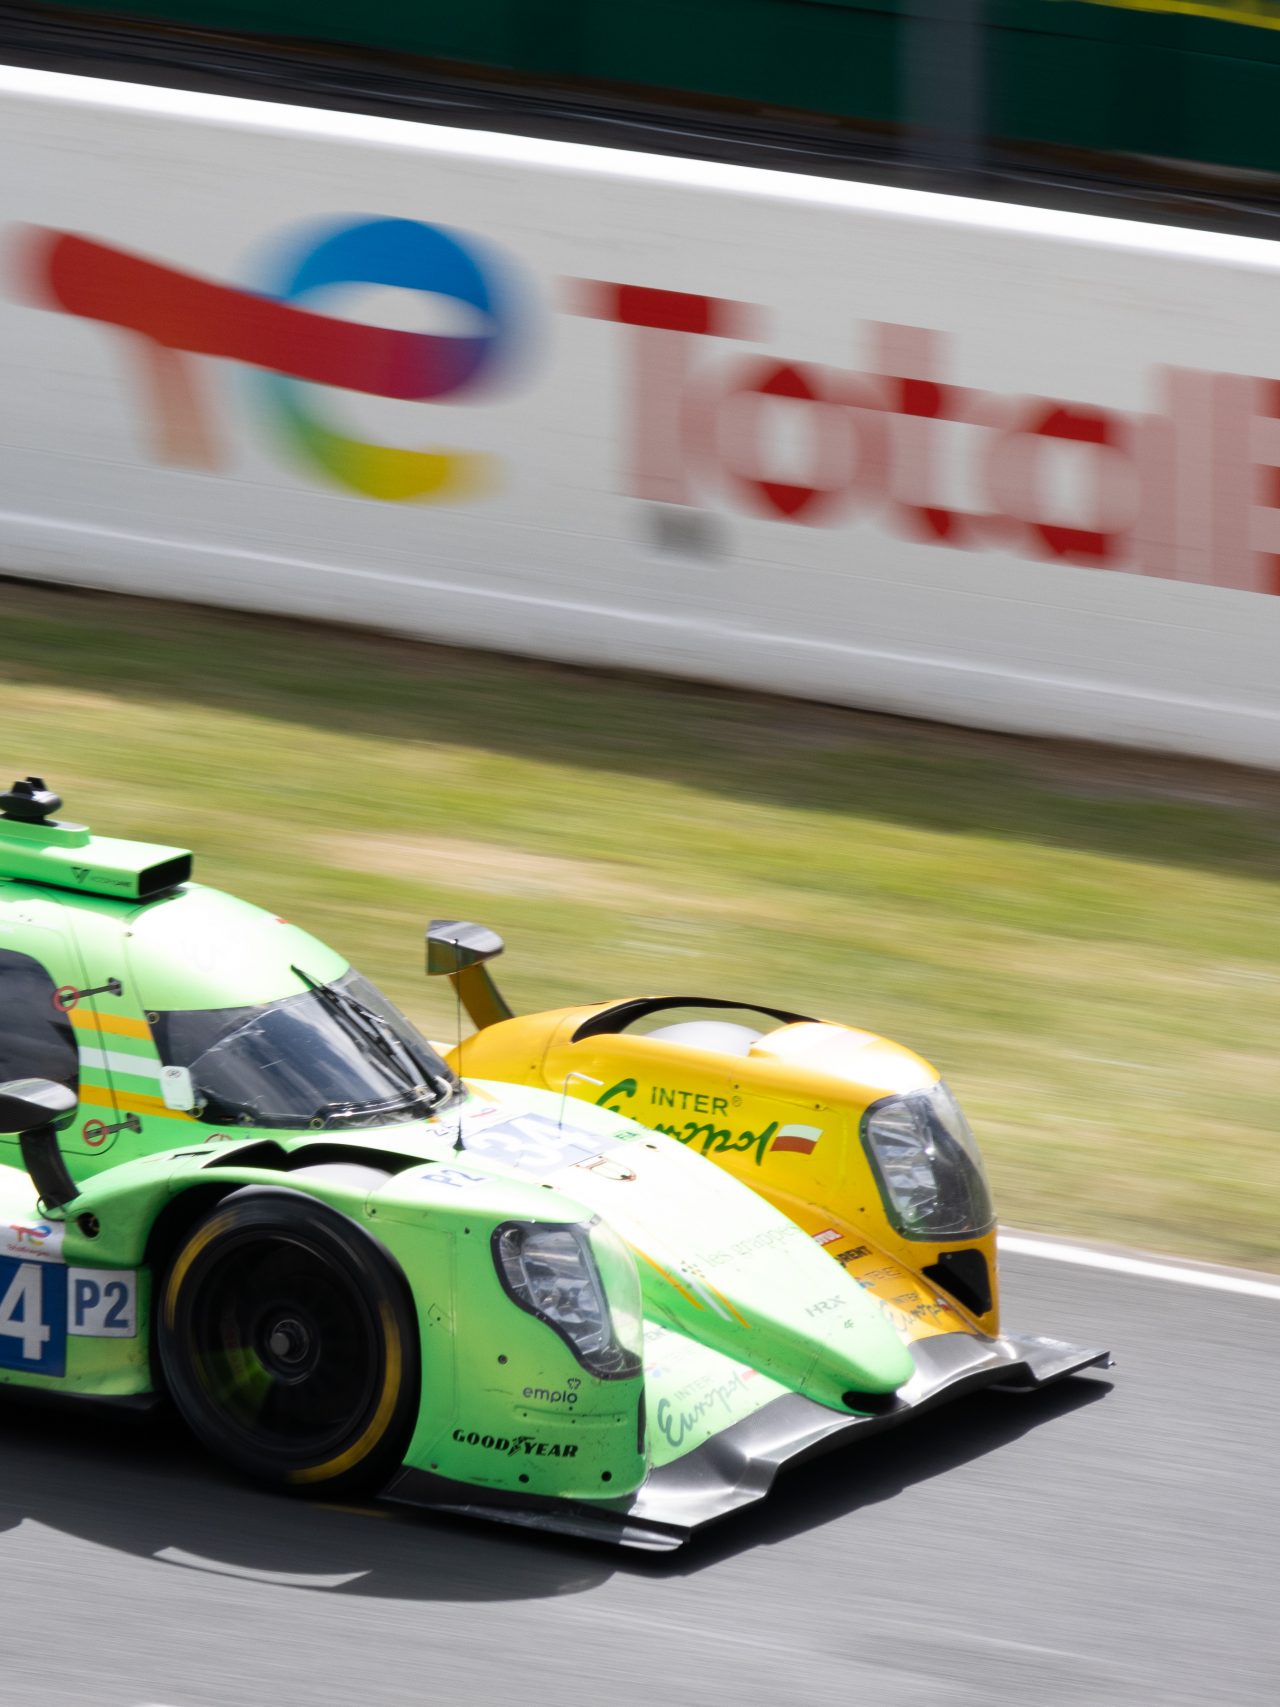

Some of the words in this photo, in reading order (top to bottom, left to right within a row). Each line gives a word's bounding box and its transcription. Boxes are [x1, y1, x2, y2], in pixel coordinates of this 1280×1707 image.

[74, 1279, 130, 1329] P2
[522, 1386, 578, 1404] emplo
[452, 1429, 579, 1458] GOODYEAR
